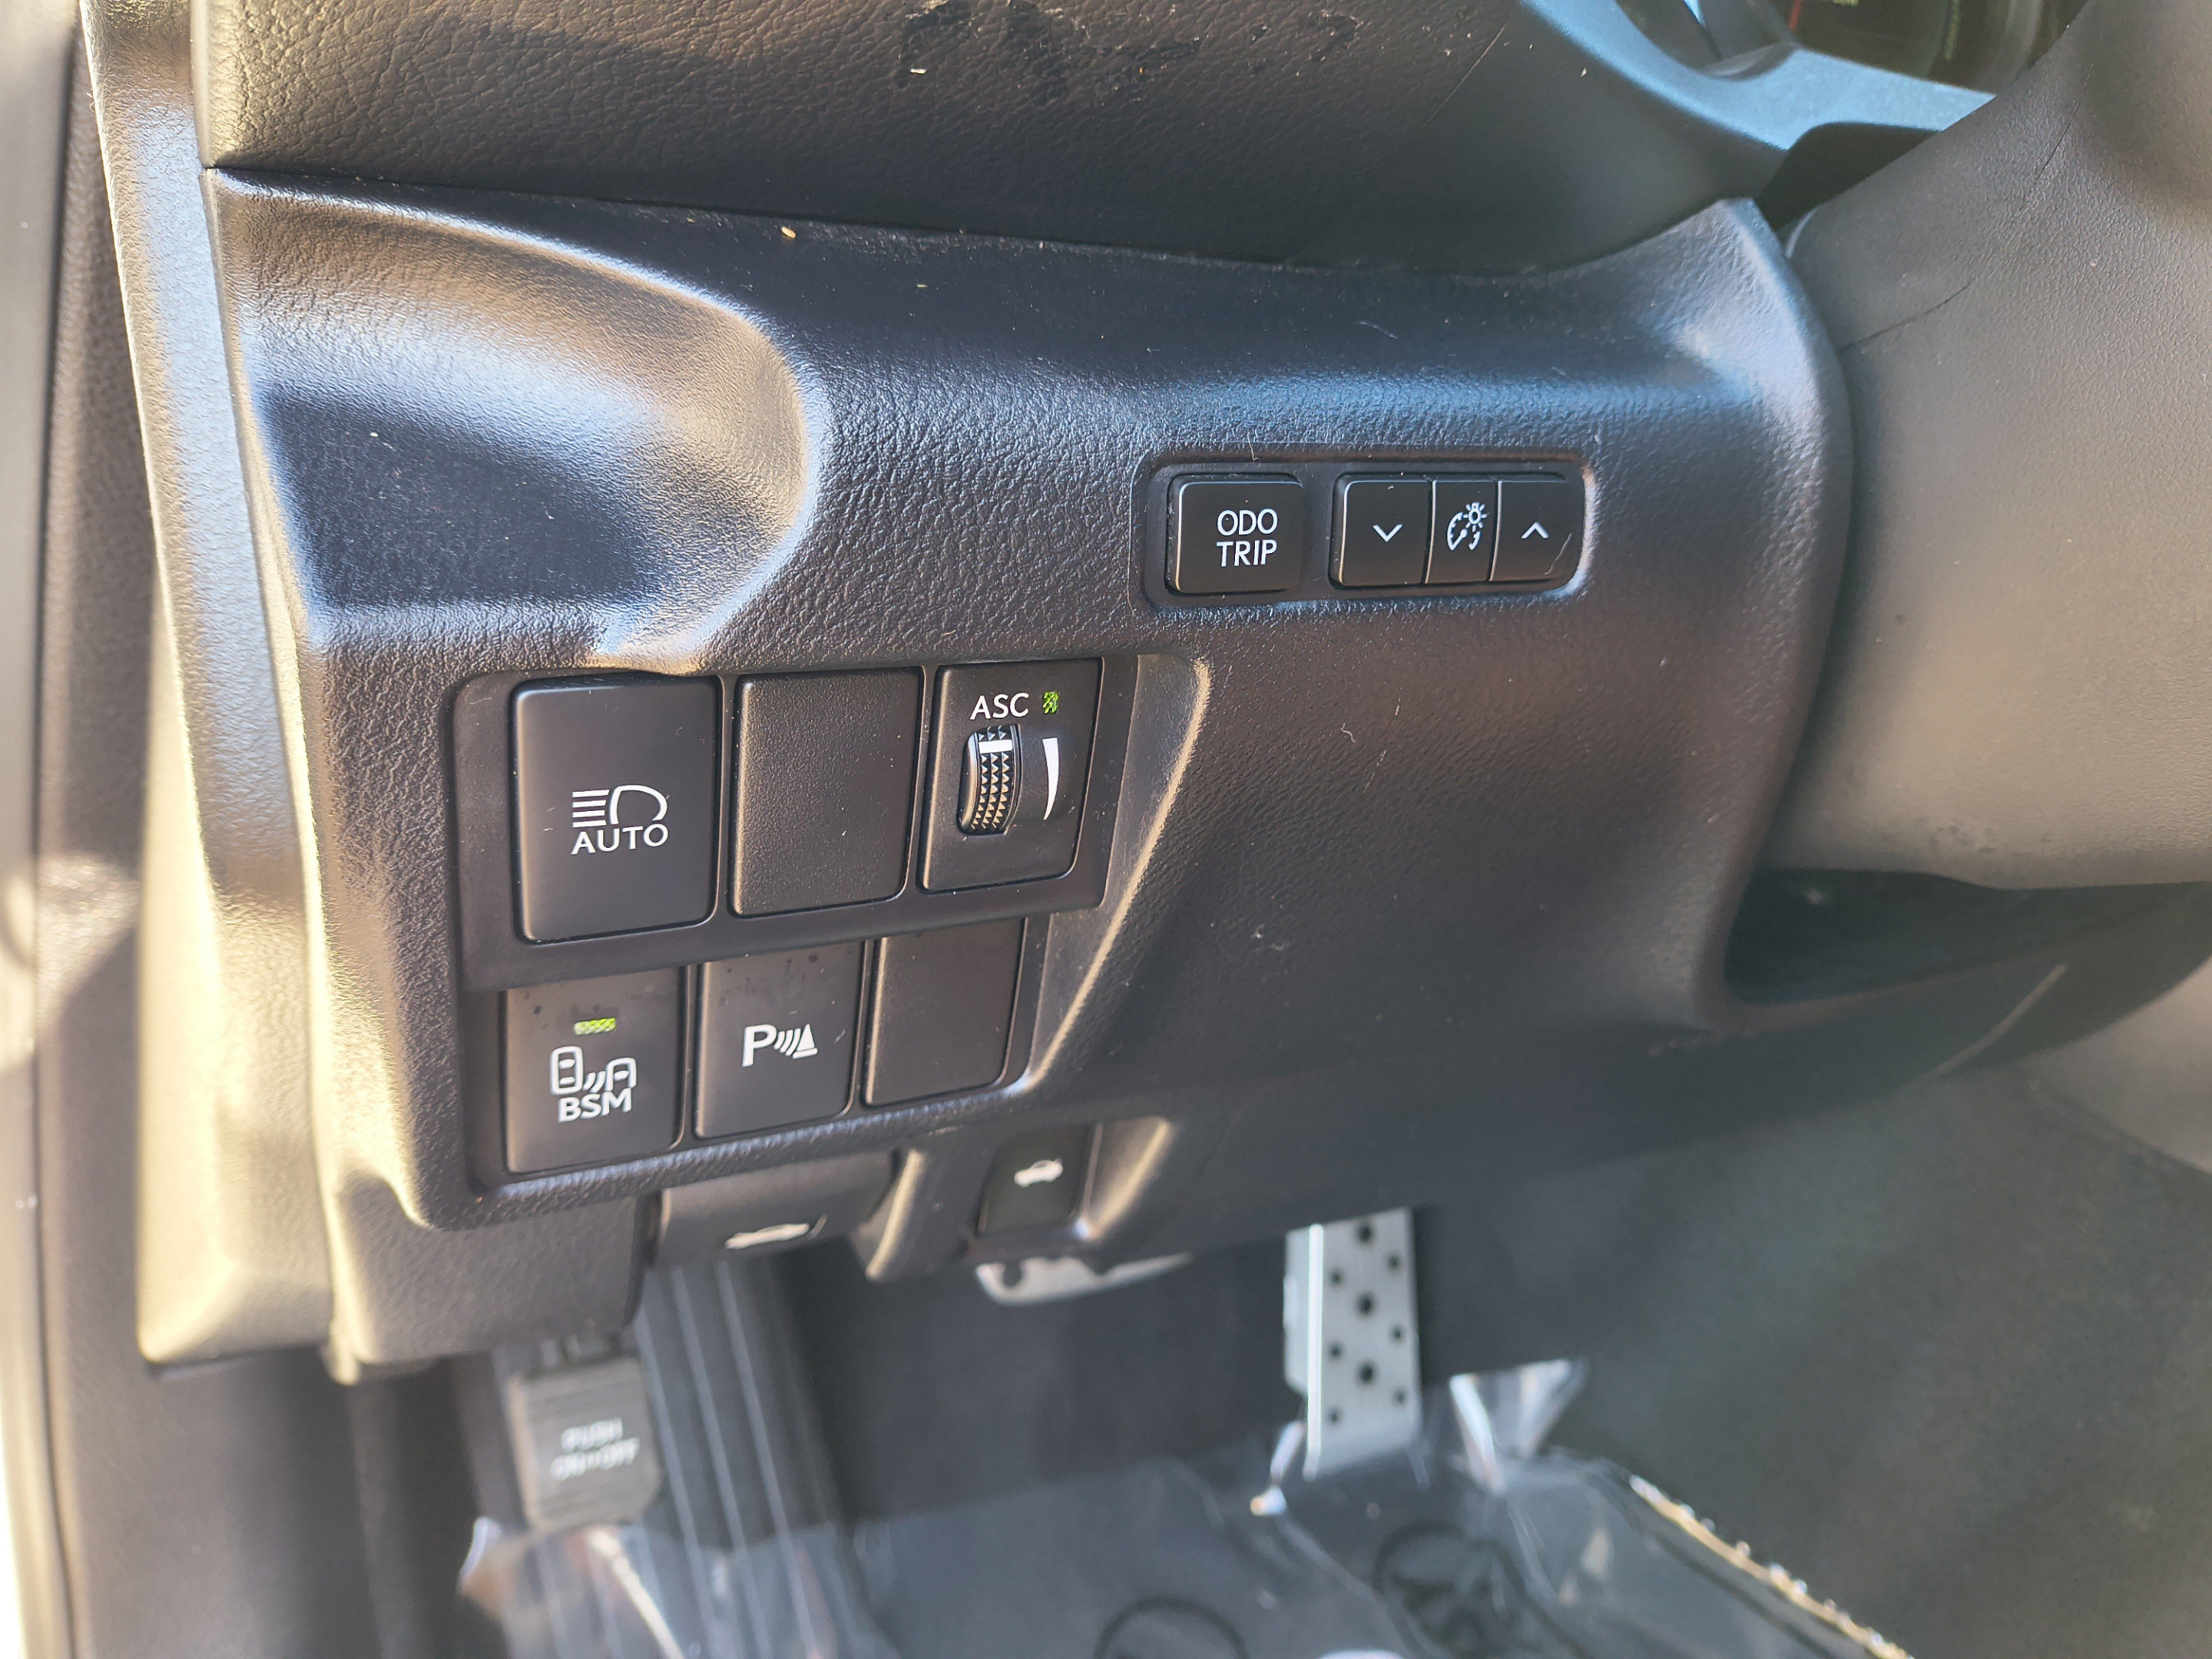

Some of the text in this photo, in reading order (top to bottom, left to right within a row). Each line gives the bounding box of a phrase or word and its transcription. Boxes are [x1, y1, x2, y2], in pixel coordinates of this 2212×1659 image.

[1217, 508, 1278, 536] ODO
[1216, 539, 1277, 567] TRIP
[969, 692, 1029, 720] ASC
[571, 823, 669, 855] AUTO
[741, 1024, 777, 1068] P
[558, 1088, 632, 1122] BSM
